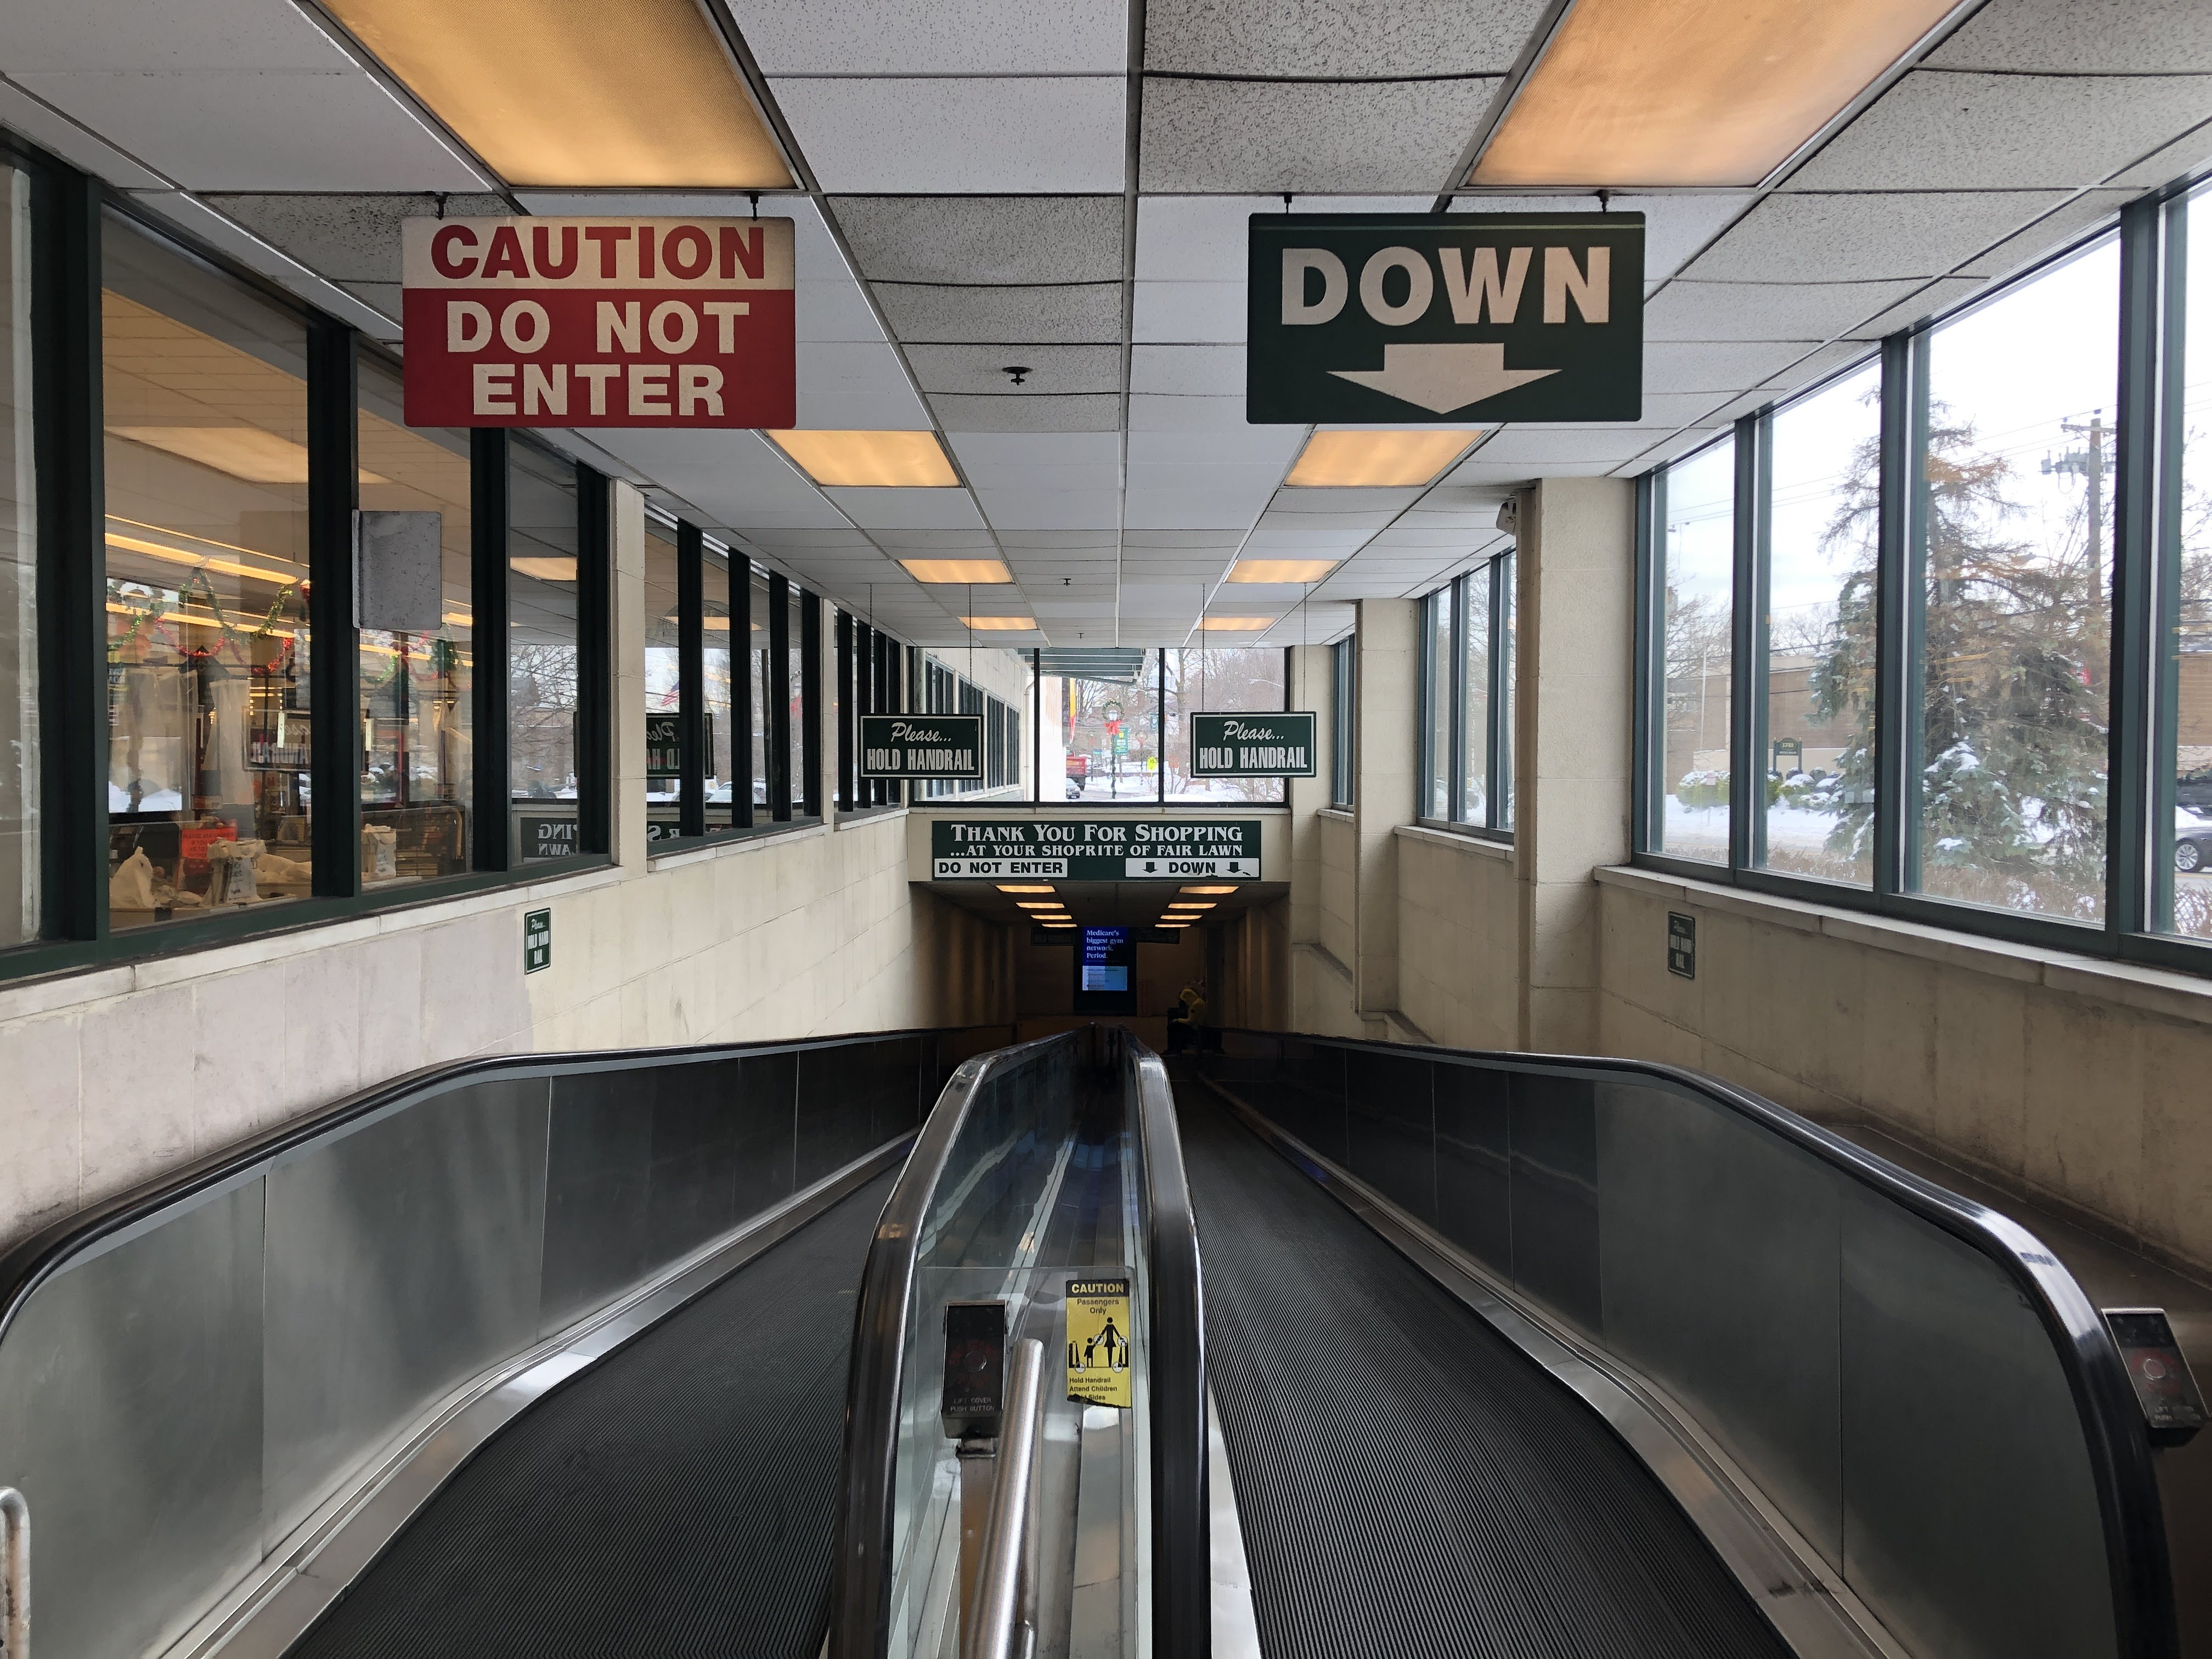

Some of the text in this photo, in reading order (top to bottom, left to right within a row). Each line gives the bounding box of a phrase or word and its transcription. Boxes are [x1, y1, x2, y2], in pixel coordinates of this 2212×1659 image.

[431, 225, 764, 280] CAUTION
[1282, 246, 1611, 326] DOWN
[447, 300, 749, 354] DO NOT
[473, 363, 725, 416] ENTER
[890, 722, 951, 742] Please...
[1223, 720, 1284, 741] Please...
[867, 748, 975, 770] HOLD HANDRAIL
[1199, 746, 1308, 769] HOLD HANDRAIL
[950, 824, 1243, 842] THANK YOU FOR SHOPPING
[993, 845, 1036, 856] YOUR
[1042, 845, 1124, 856] SHOPRITE
[1130, 845, 1151, 856] OF
[1157, 845, 1193, 856] FAIR
[1199, 845, 1243, 856] LAWN
[939, 861, 1063, 873] DO NOT ENTER
[1169, 862, 1216, 873] DOWN
[1071, 1283, 1124, 1294] CAUTION
[1090, 1307, 1107, 1316] Only
